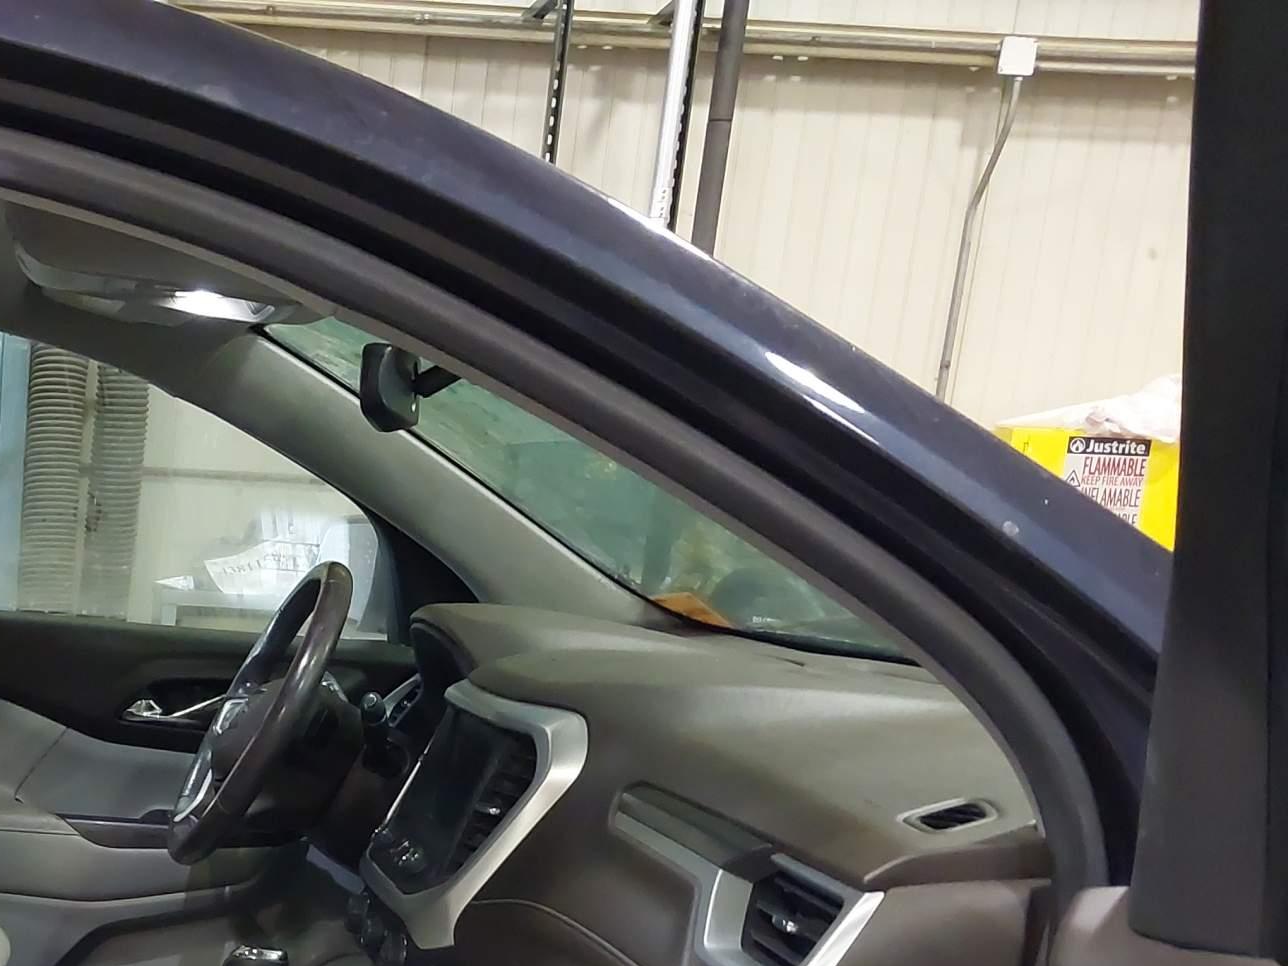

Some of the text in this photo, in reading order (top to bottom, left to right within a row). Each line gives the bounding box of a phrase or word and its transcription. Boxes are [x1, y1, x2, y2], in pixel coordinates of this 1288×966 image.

[1087, 440, 1145, 454] Justrite
[1083, 457, 1146, 476] FLAMMABLE
[1081, 476, 1143, 487] KEEP FIRE AWAY
